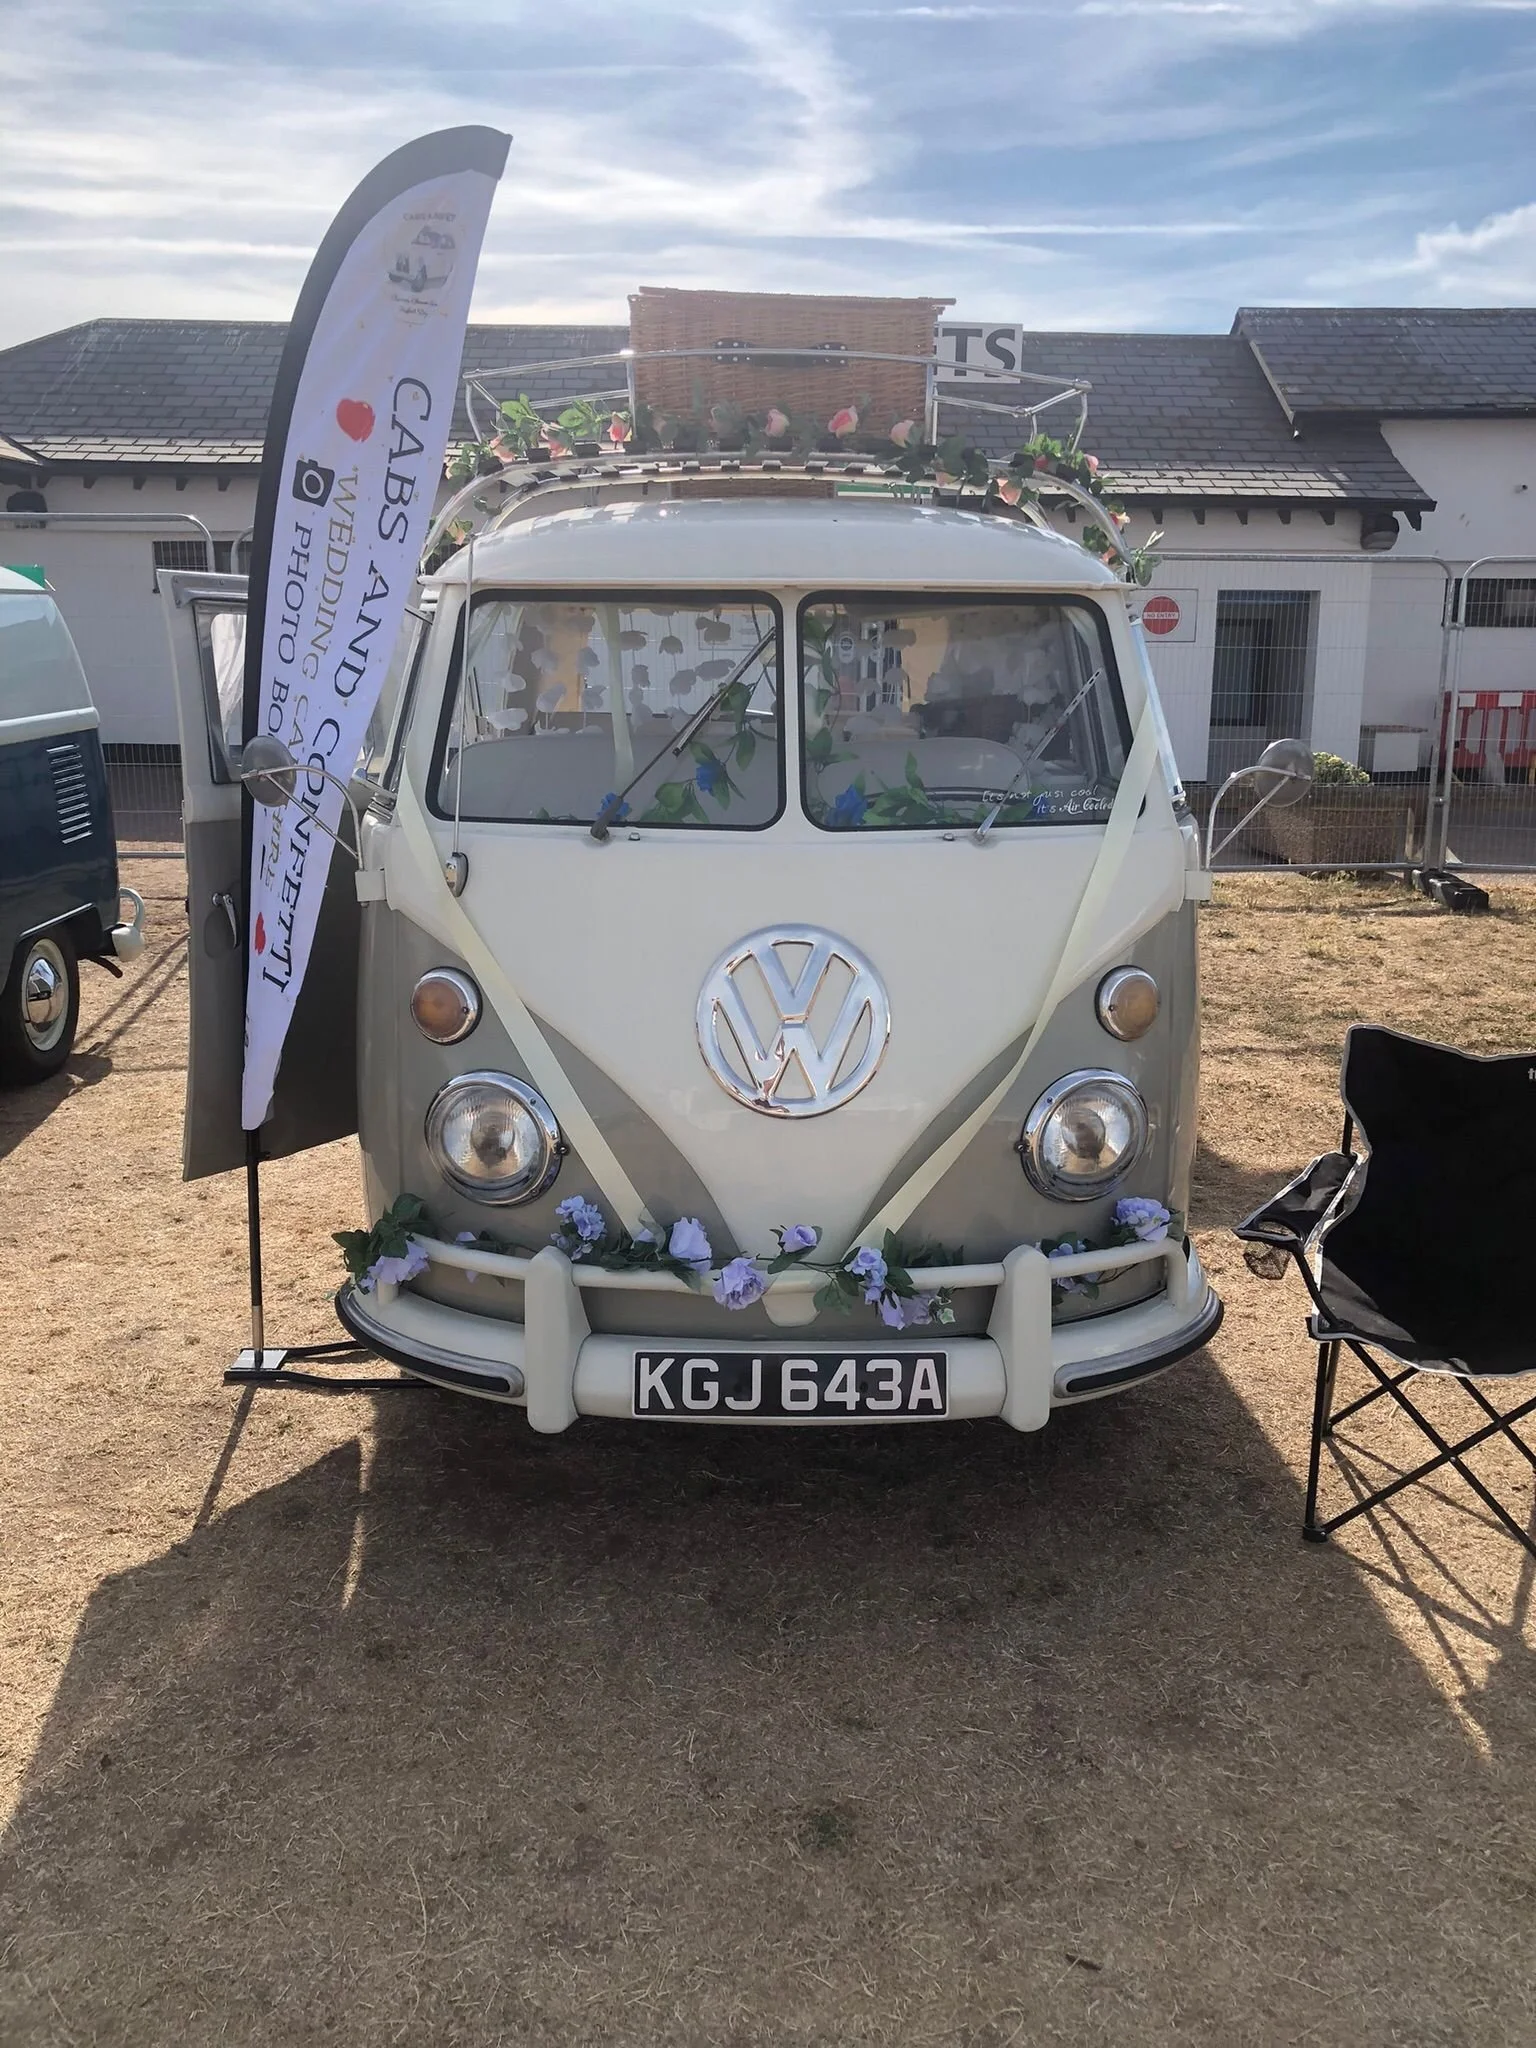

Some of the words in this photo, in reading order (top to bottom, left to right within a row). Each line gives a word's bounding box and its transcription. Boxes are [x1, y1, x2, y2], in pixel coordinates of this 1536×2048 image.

[933, 327, 1016, 378] TS
[378, 377, 432, 543] CABS
[278, 522, 312, 664] PHOTO
[302, 475, 358, 680] WEDDING
[334, 560, 389, 698] AND
[263, 718, 340, 993] CONFETTI
[1059, 799, 1083, 815] Air
[1070, 784, 1098, 797] cool
[639, 1358, 762, 1411] KGJ
[780, 1358, 944, 1411] 643A
